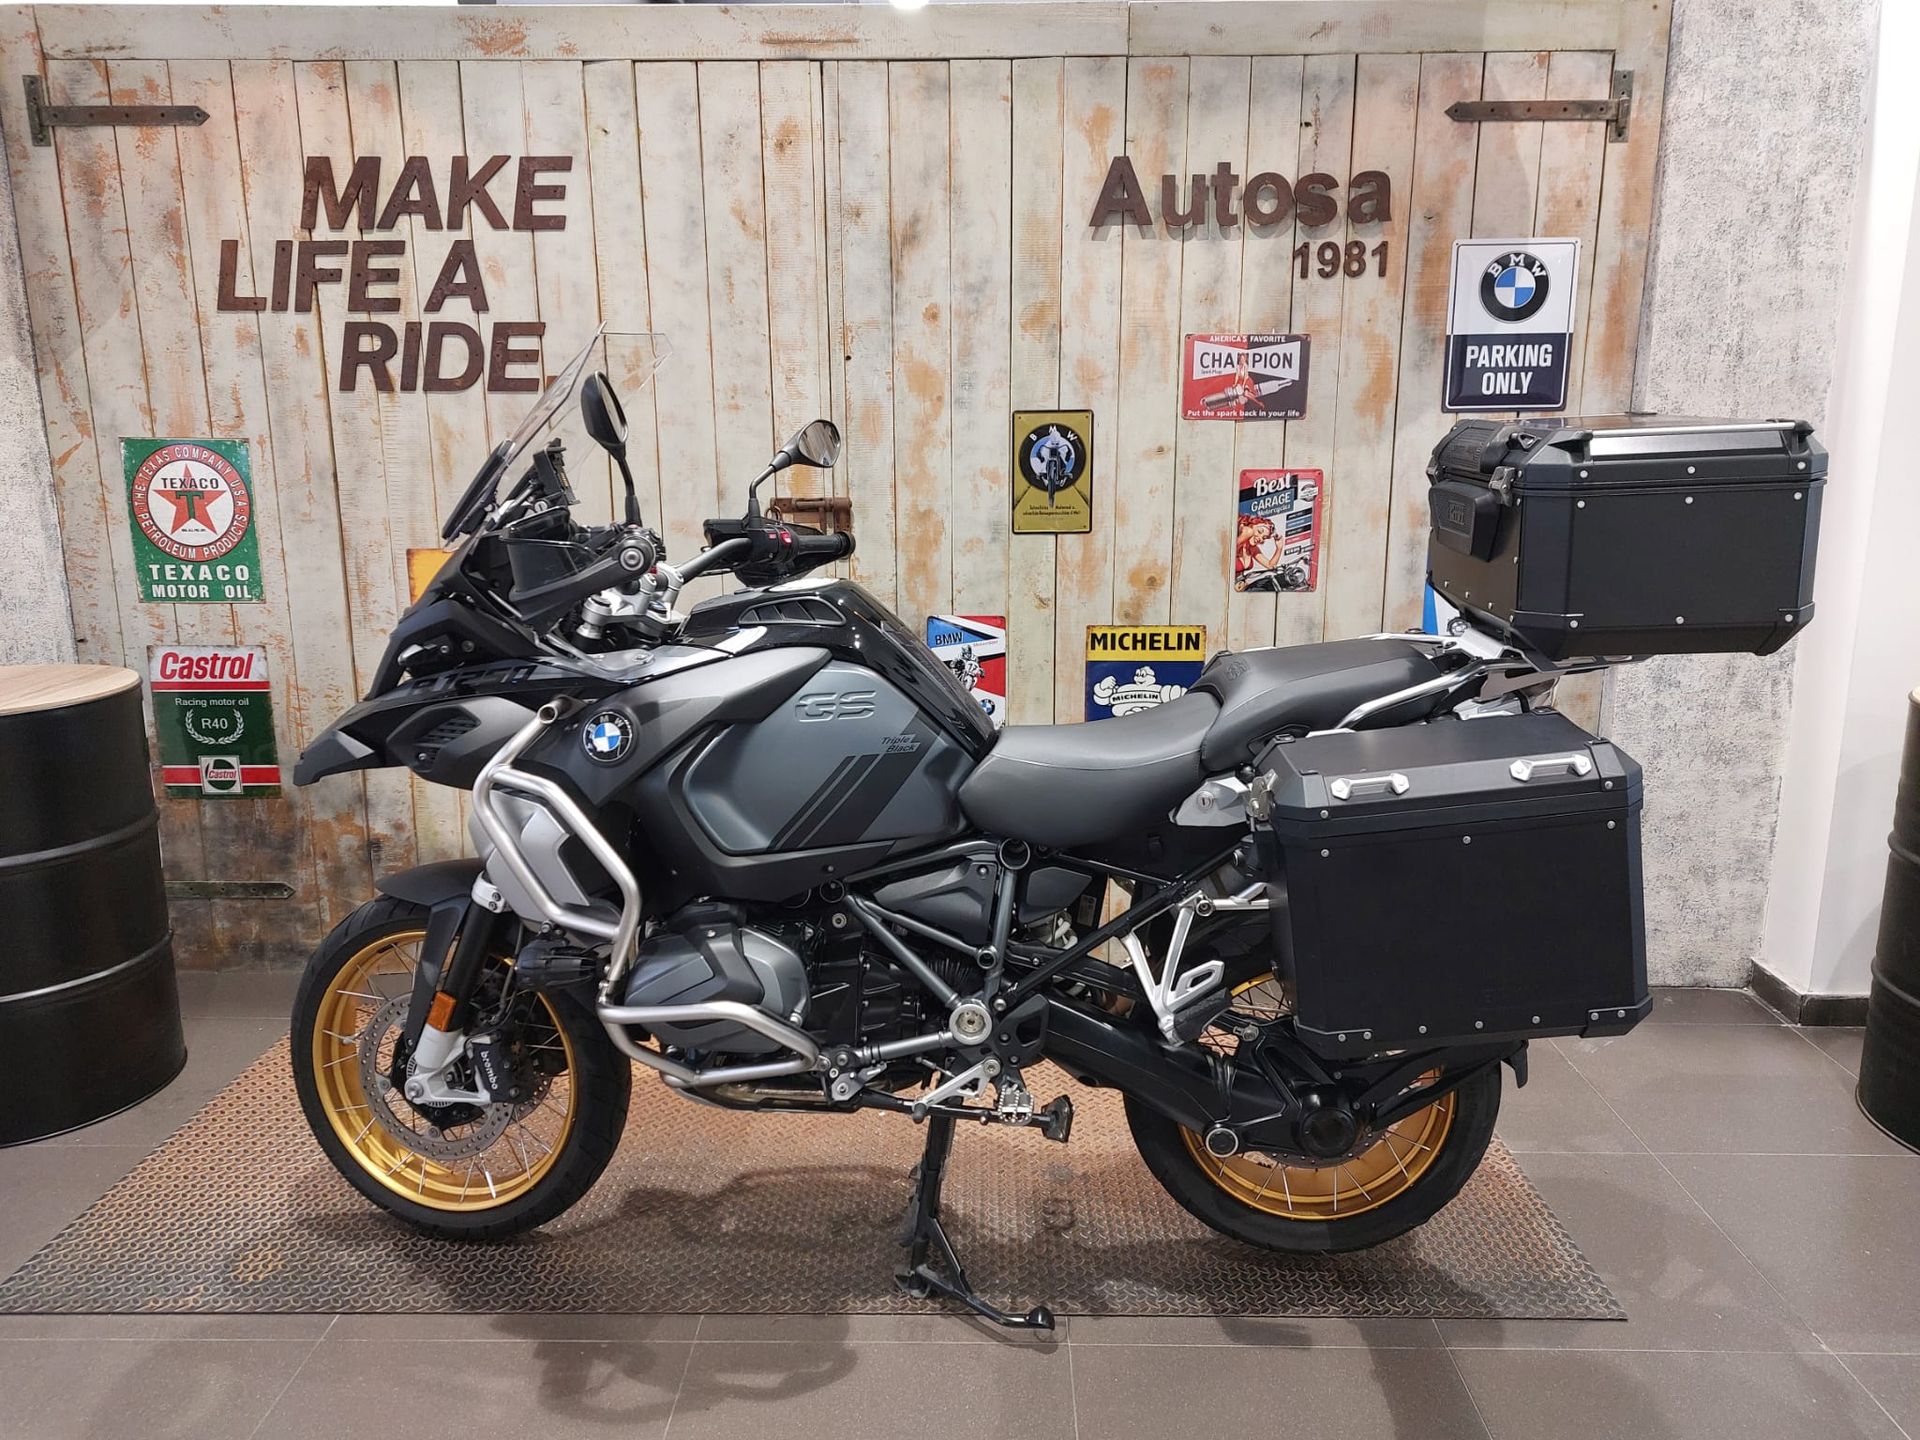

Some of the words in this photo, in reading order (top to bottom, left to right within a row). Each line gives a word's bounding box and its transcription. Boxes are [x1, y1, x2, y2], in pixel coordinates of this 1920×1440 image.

[301, 156, 573, 230] MAKE
[1089, 156, 1393, 227] Autosa
[1293, 240, 1389, 279] 1981
[1487, 254, 1547, 278] BMW
[217, 240, 406, 312] LIFE
[424, 240, 489, 312] A
[1250, 335, 1286, 343] FAVORITE
[1465, 344, 1553, 368] PARKING
[1481, 371, 1533, 395] ONLY
[1187, 409, 1200, 417] Put
[1202, 409, 1215, 417] the
[1216, 409, 1238, 419] spark
[1239, 409, 1257, 417] back
[1268, 410, 1286, 419] your
[1287, 408, 1300, 417] life
[1029, 425, 1078, 442] BMW
[138, 450, 171, 483] TEXAS
[174, 446, 233, 477] COMPANY
[161, 477, 219, 490] TEXACO
[1253, 472, 1291, 497] Best
[134, 484, 147, 507] THE
[1251, 491, 1291, 512] GARAGE
[137, 512, 196, 559] PETROLEUM
[203, 513, 248, 559] PRODUCTS
[149, 564, 249, 581] TEXACO
[152, 585, 210, 599] MOTOR
[224, 585, 252, 599] OIL
[934, 632, 964, 646] BMW
[1090, 632, 1201, 651] MICHELIN
[160, 652, 254, 680] Castrol
[175, 698, 207, 708] Racing
[209, 698, 236, 706] motor
[238, 697, 249, 706] oil
[795, 690, 877, 722] GS
[1112, 694, 1159, 702] MICHELIN
[201, 718, 228, 729] R40
[588, 715, 625, 732] BMW
[881, 736, 910, 746] Triple
[886, 744, 916, 753] Black
[208, 769, 237, 780] Castrol
[480, 1050, 498, 1090] brembo
